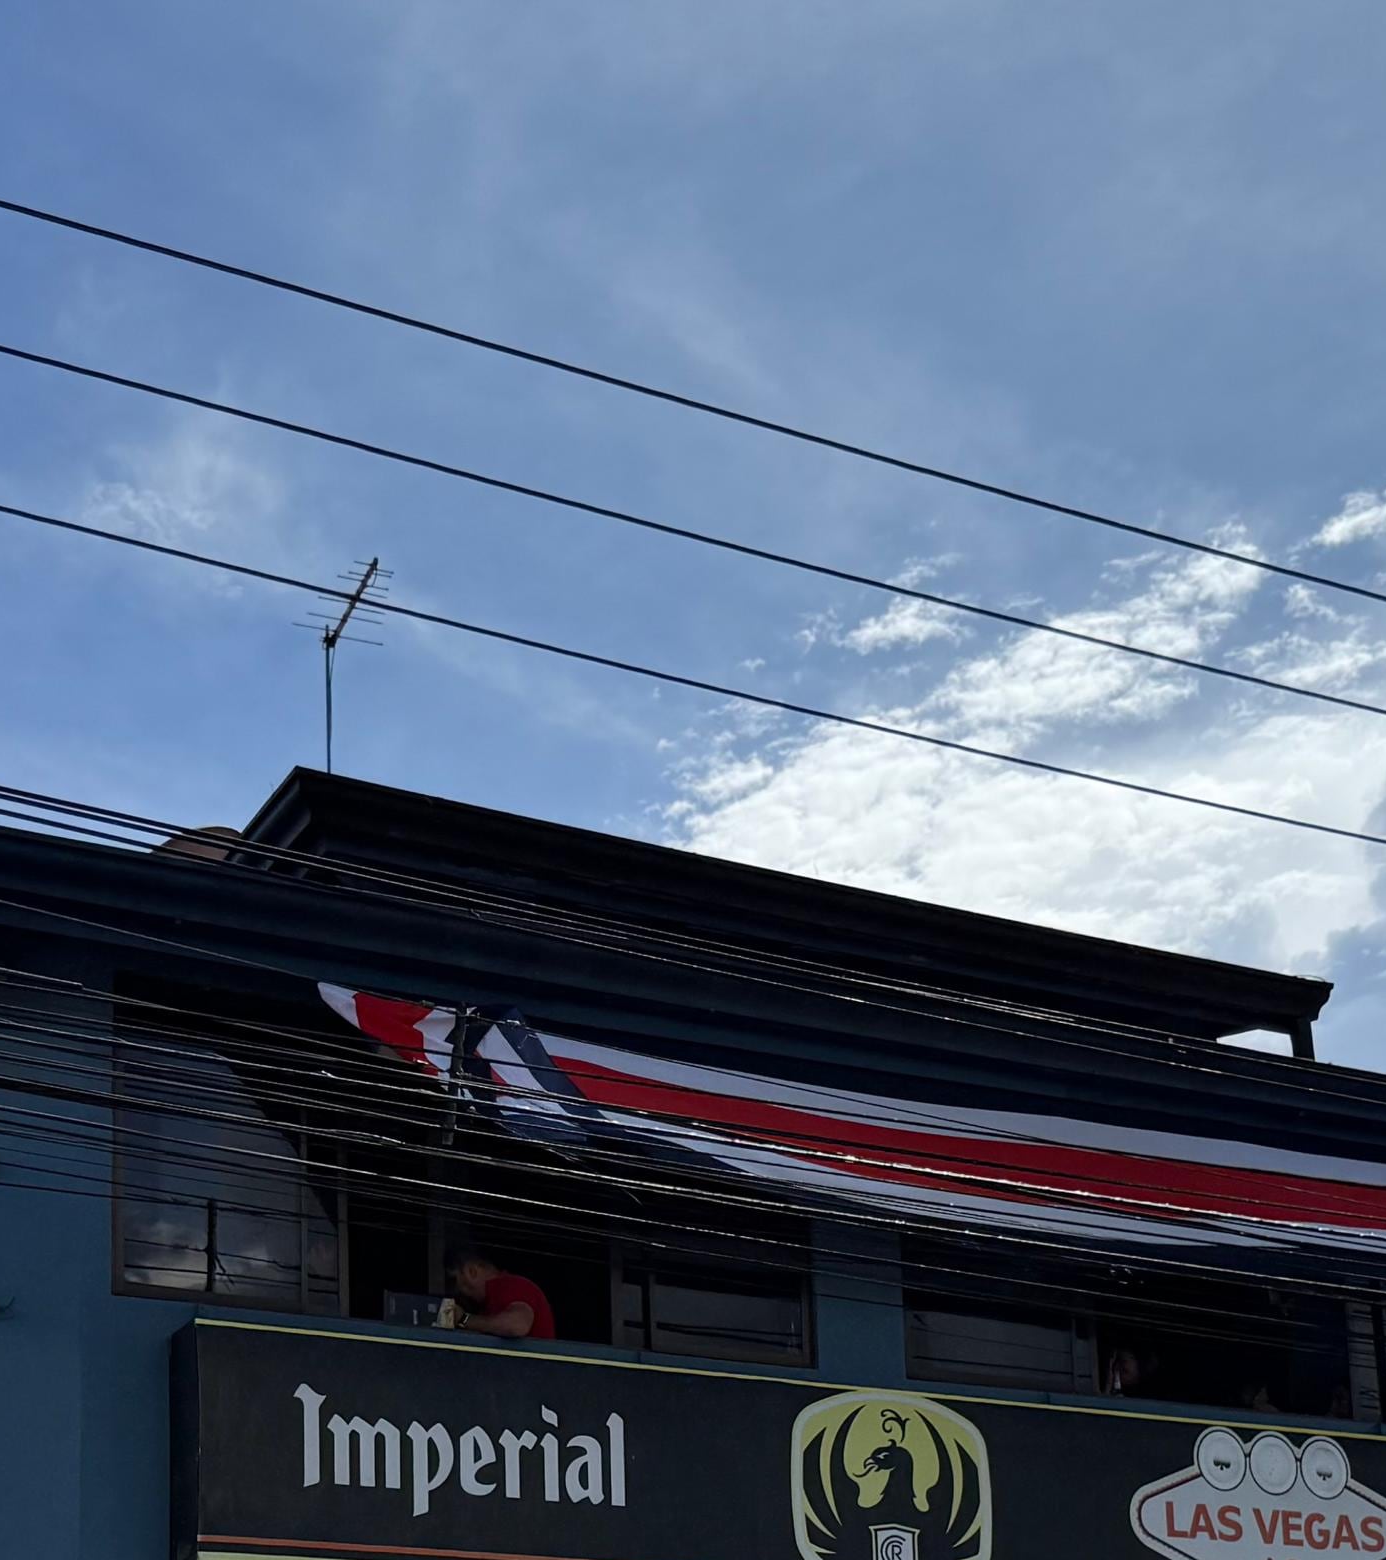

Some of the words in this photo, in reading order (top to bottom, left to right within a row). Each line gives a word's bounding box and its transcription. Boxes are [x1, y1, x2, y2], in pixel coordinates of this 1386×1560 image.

[293, 1383, 627, 1517] Imperial
[1165, 1501, 1243, 1542] LAS
[1253, 1507, 1385, 1552] VEGAS
